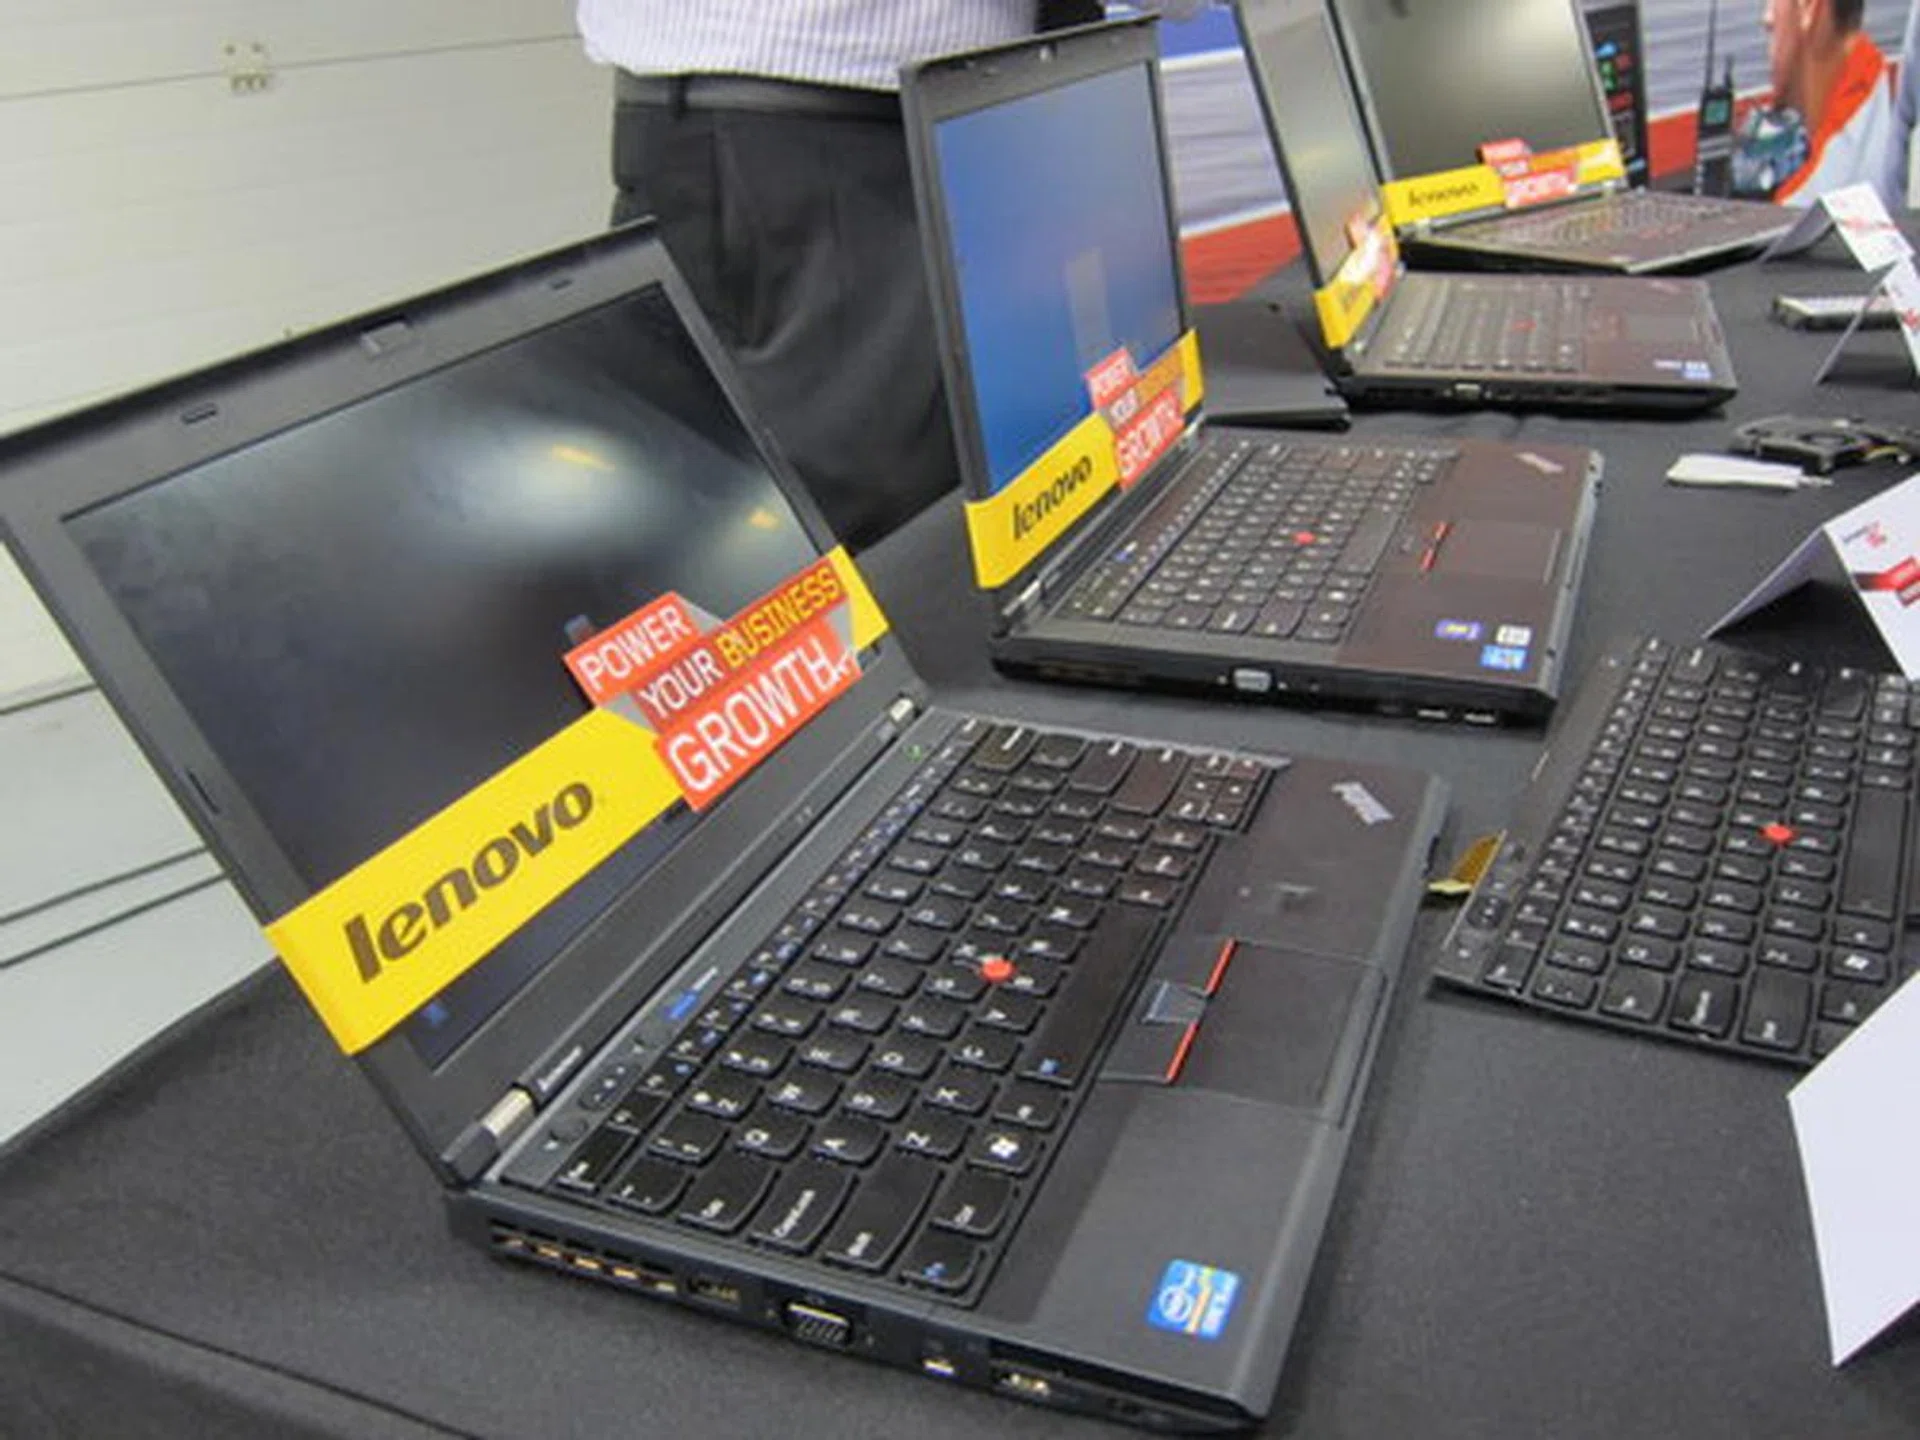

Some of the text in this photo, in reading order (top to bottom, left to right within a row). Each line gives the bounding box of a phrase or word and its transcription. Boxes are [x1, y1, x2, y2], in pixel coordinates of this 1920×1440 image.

[1012, 455, 1092, 540] lenovo
[575, 601, 692, 693] POWER
[638, 566, 843, 718] YOUR BUSINESS
[343, 781, 595, 983] lenovo
